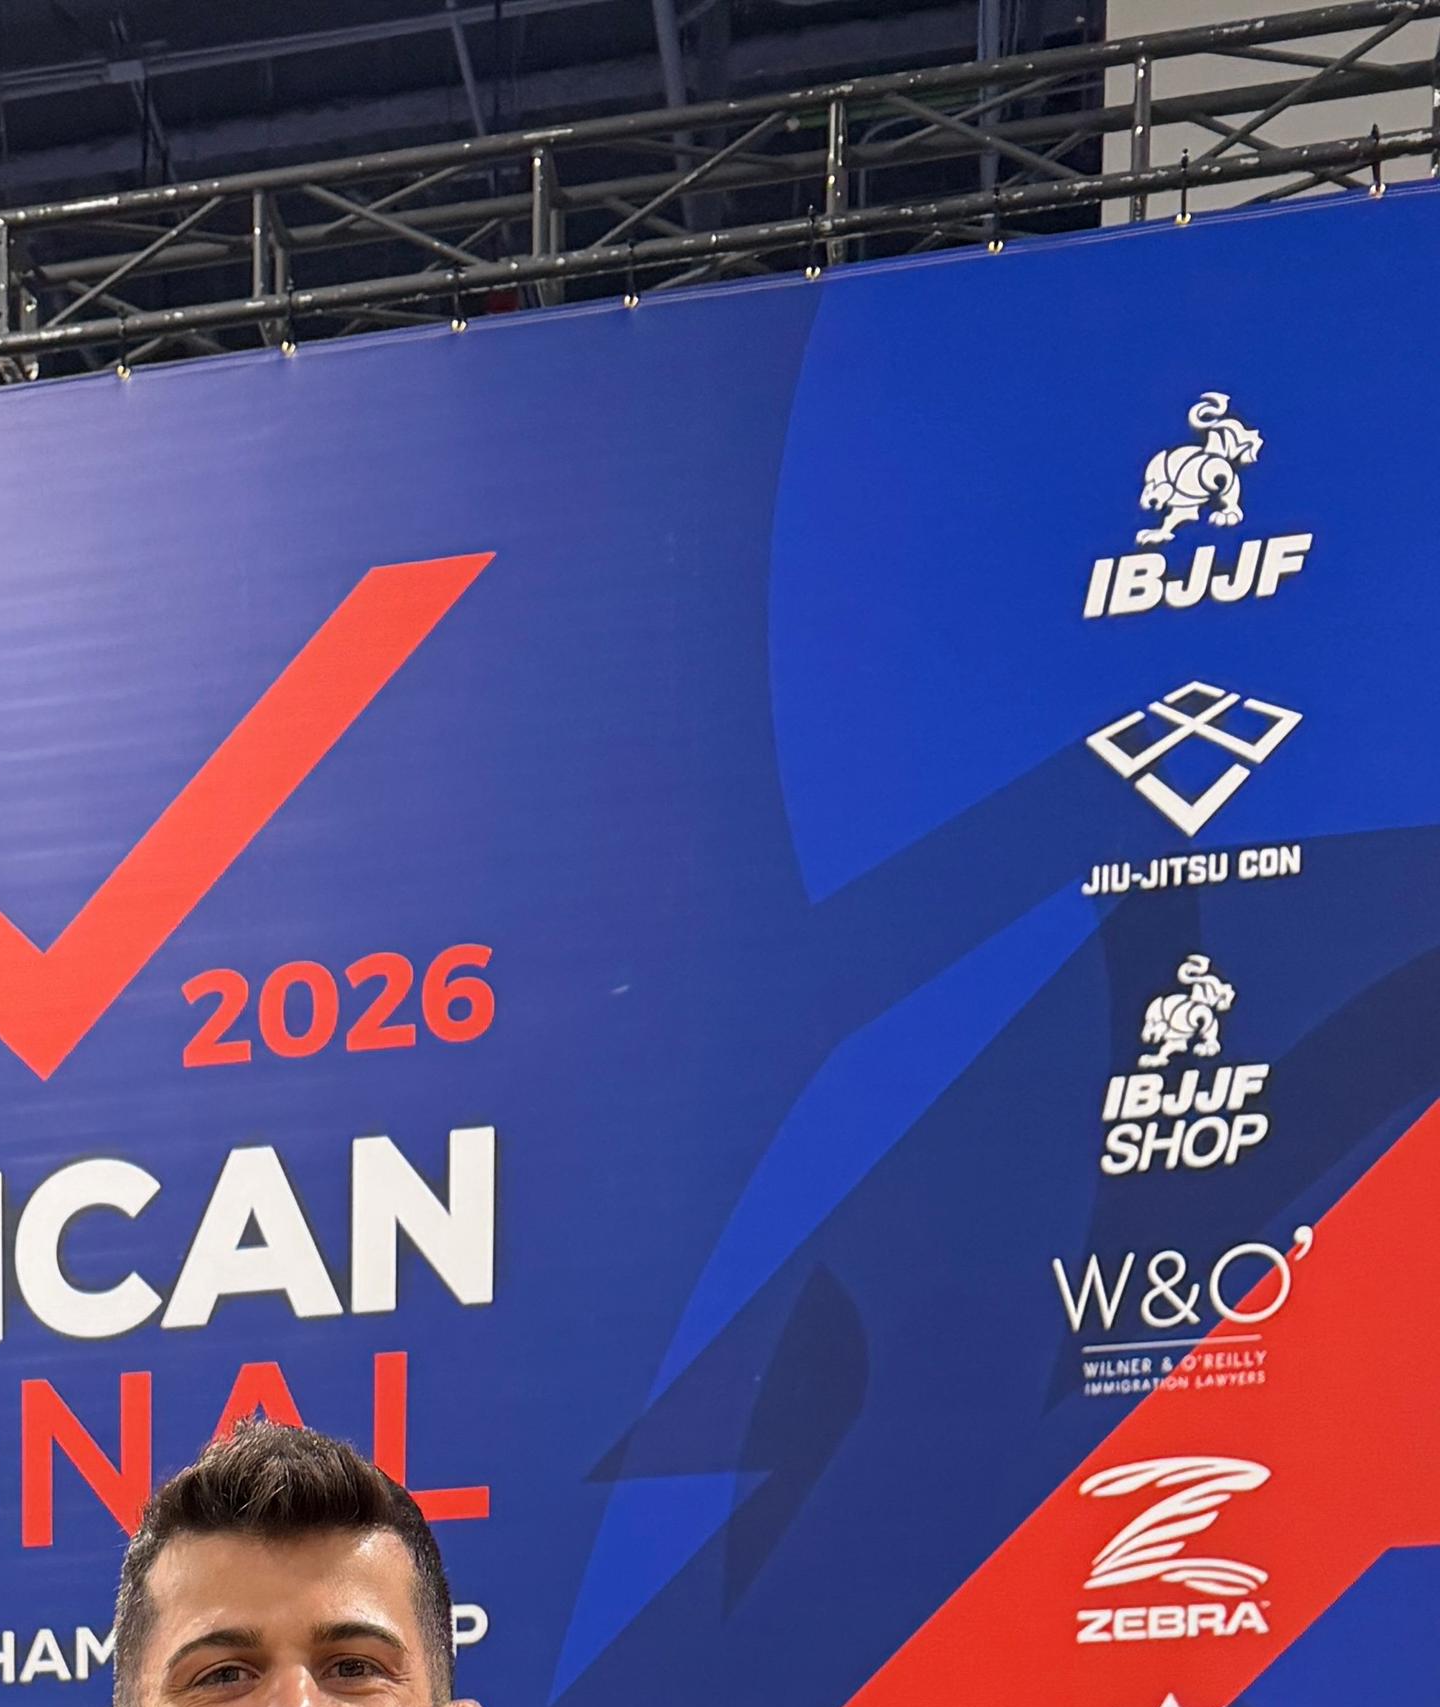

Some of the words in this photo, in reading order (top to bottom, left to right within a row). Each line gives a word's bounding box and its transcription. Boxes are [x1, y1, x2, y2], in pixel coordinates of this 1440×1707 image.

[1083, 534, 1313, 618] IBJJF
[1081, 853, 1228, 895] JIU-JITSU
[1238, 845, 1301, 879] CON
[181, 942, 495, 1068] 2026
[1102, 1063, 1270, 1122] IBJJF
[1101, 1113, 1269, 1175] SHOP
[1082, 1357, 1152, 1378] WILNER
[1161, 1356, 1173, 1373] &
[1182, 1350, 1268, 1372] O'REILLY
[1194, 1370, 1267, 1390] LAWYERS
[1076, 1602, 1269, 1643] ZEBRA
